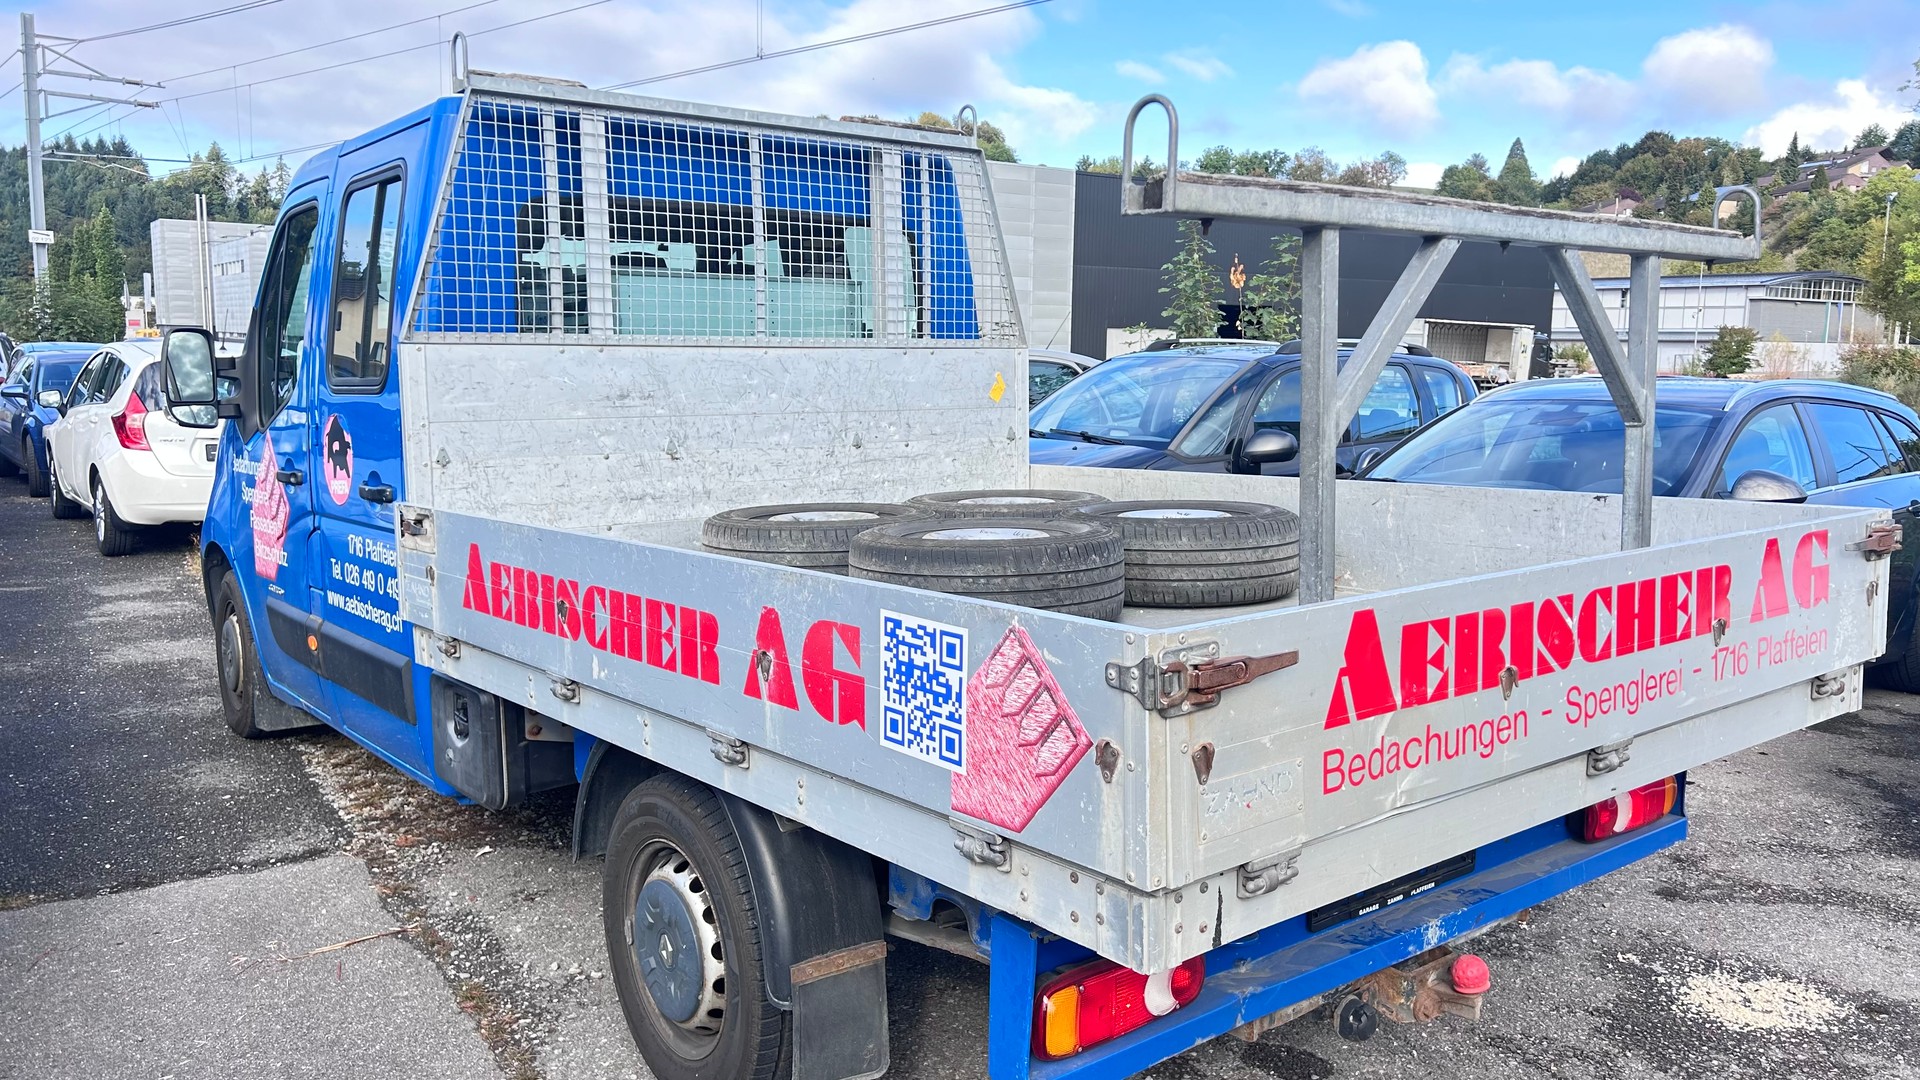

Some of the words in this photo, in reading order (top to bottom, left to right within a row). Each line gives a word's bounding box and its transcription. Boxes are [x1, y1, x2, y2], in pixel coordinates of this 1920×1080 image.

[348, 534, 363, 558] 1716
[330, 558, 343, 581] Tel.
[344, 562, 360, 587] 026
[361, 568, 375, 592] 419
[377, 572, 384, 595] 0
[327, 589, 403, 633] www.aebischerag.ch
[1323, 565, 1733, 730] AEBISCHER
[1750, 530, 1830, 623] AG
[462, 543, 721, 686] AEBISCHER
[743, 606, 866, 733] AG
[1323, 709, 1528, 796] Bedachungen
[1565, 658, 1683, 728] Spenglerei
[1711, 640, 1749, 682] 1716
[1757, 625, 1828, 670] Plaffeien
[1204, 770, 1293, 817] ZAHND
[1358, 903, 1379, 916] GARAGE
[1387, 894, 1404, 905] ZAHND
